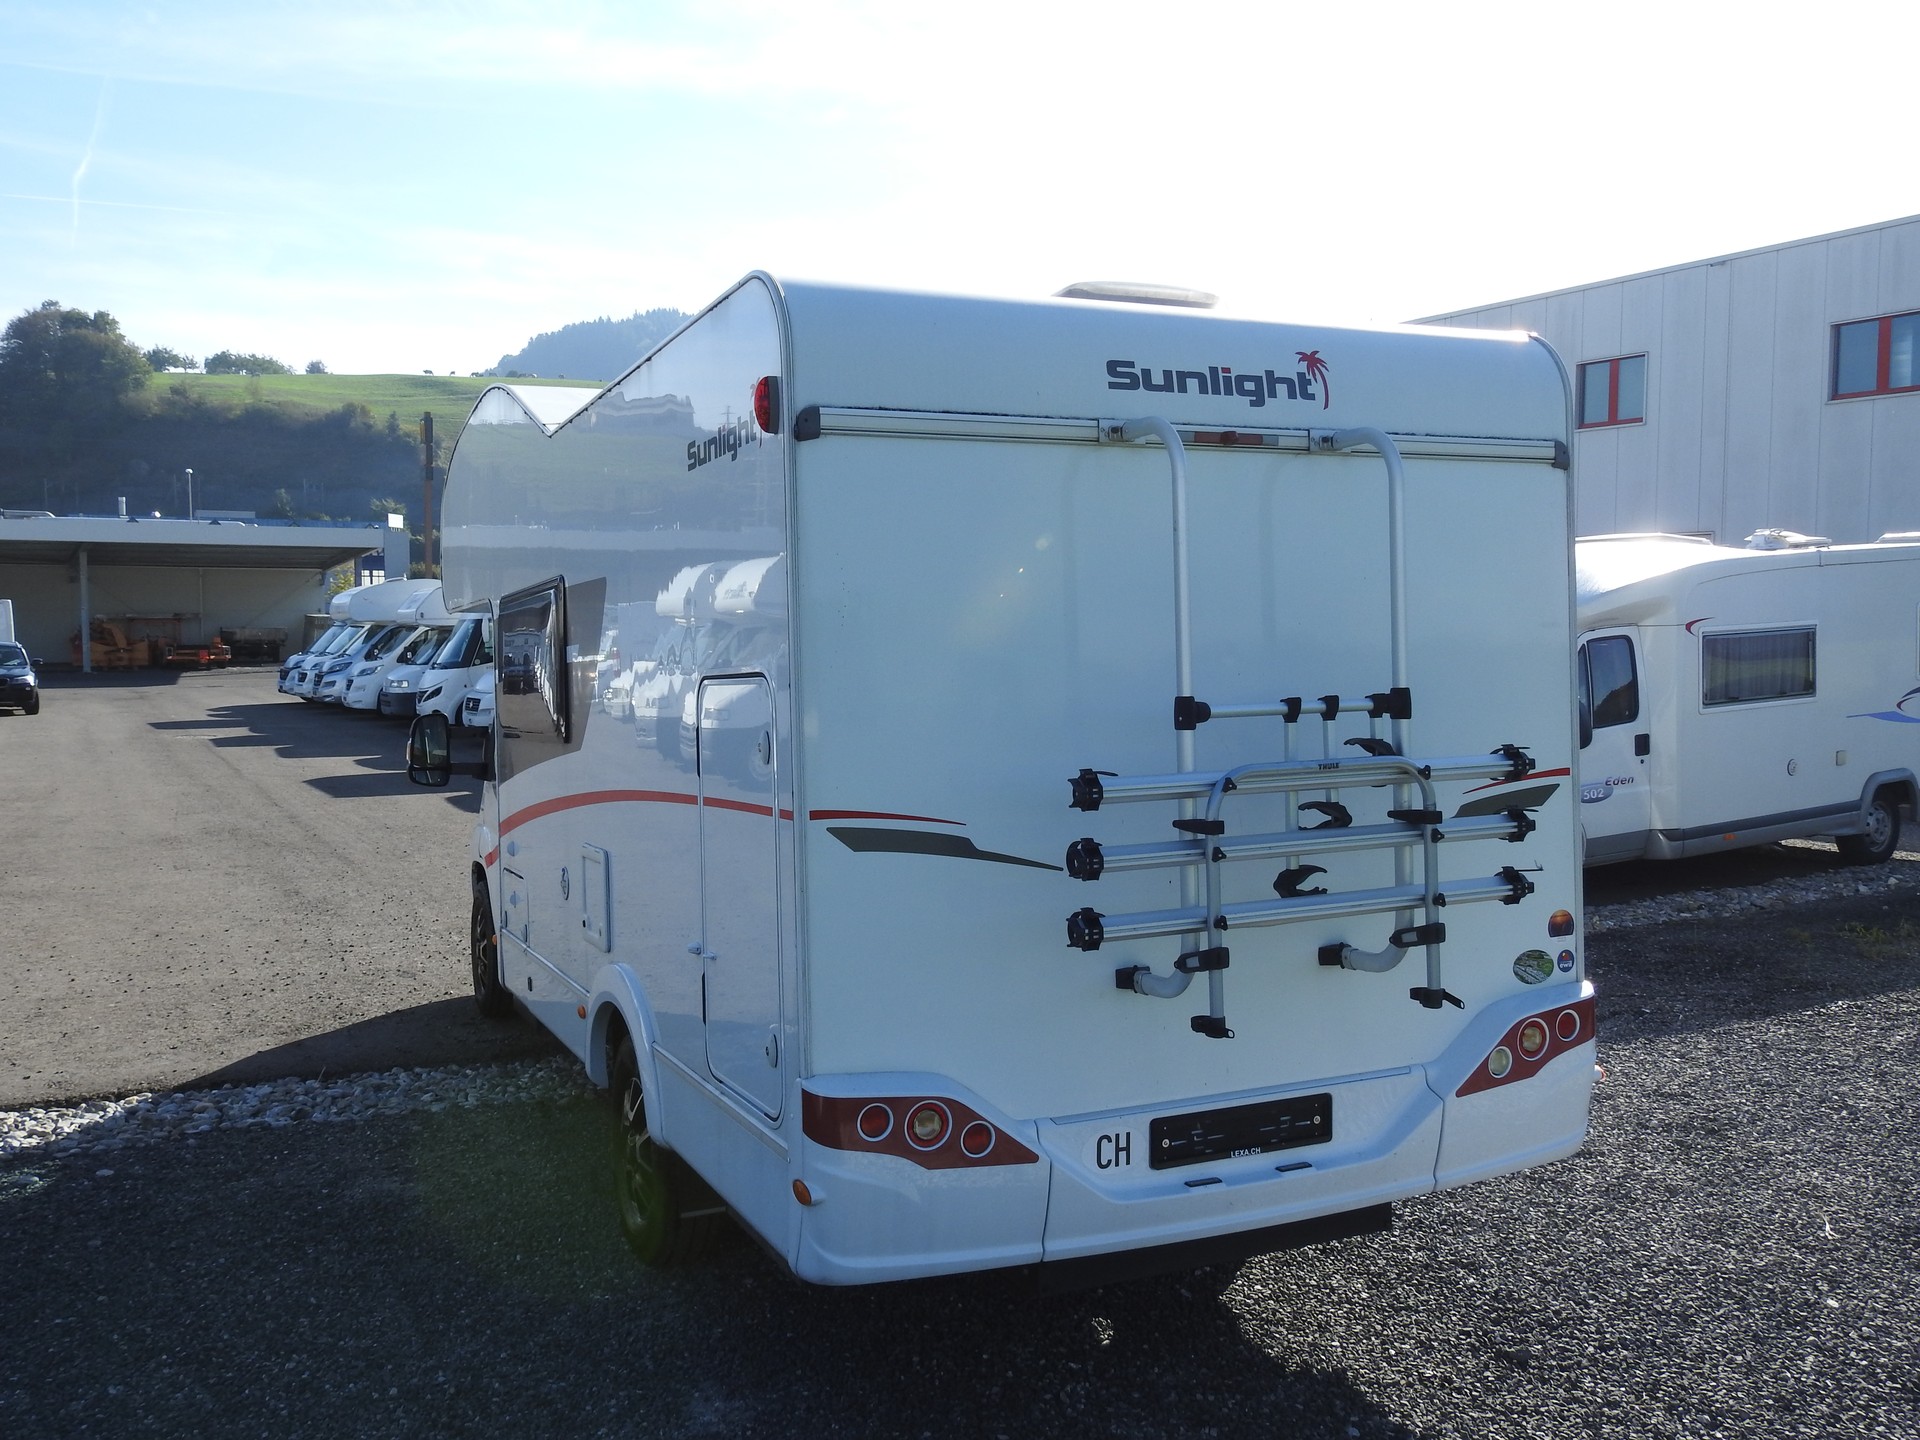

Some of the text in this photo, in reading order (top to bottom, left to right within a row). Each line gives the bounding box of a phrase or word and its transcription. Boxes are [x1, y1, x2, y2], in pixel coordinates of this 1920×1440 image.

[1106, 360, 1316, 408] Sunlight
[687, 409, 757, 472] Sunlight
[1317, 762, 1340, 770] THULE
[1605, 776, 1634, 786] Eden
[1583, 788, 1604, 800] 502
[1096, 1131, 1131, 1169] CH
